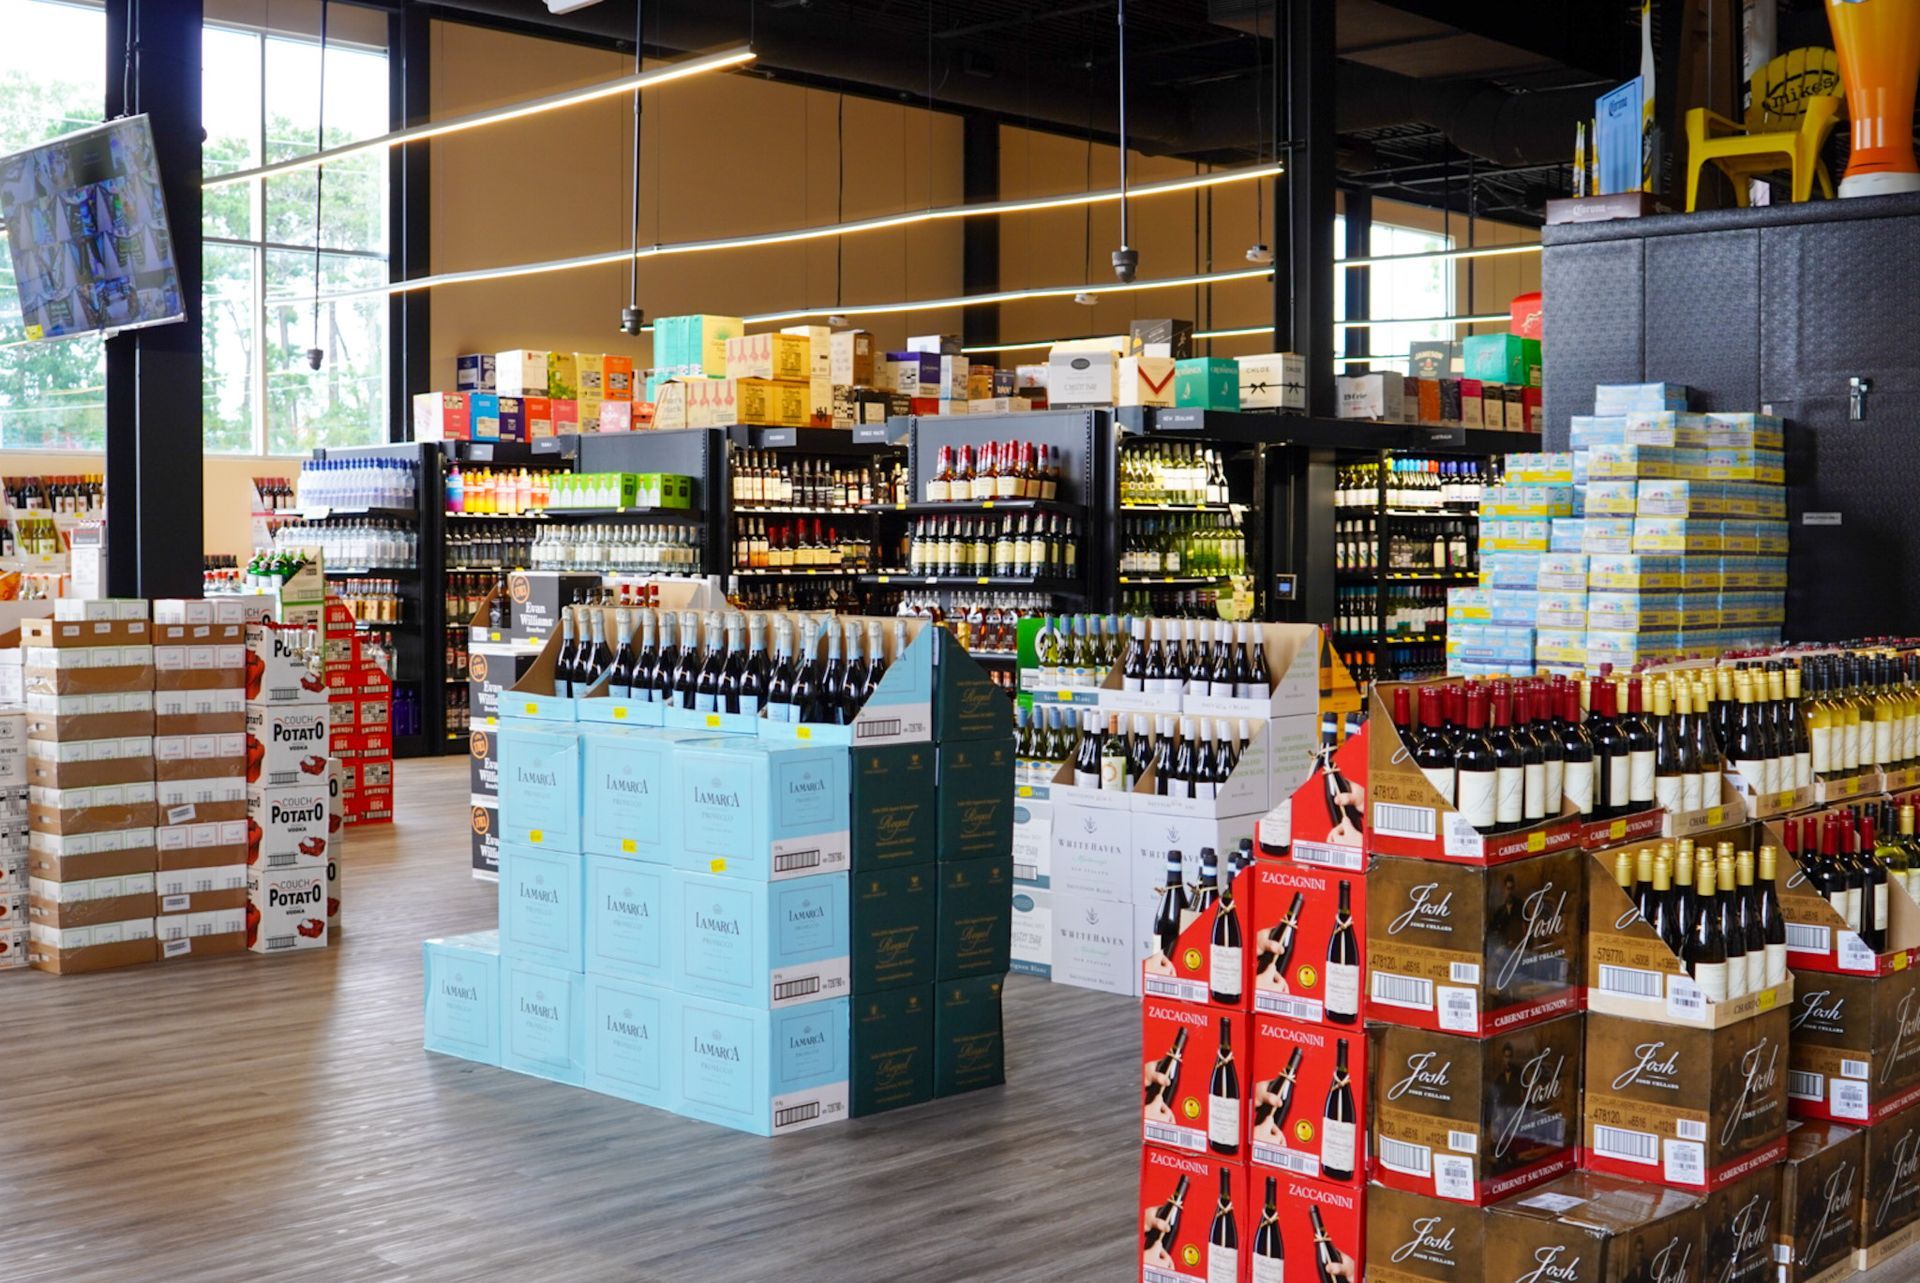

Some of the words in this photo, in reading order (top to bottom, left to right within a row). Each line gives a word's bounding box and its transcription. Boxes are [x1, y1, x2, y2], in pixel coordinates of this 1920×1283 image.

[1572, 204, 1606, 217] Corona
[525, 601, 546, 614] Evan
[519, 613, 554, 627] Williams
[284, 715, 313, 724] COUCH
[273, 721, 324, 742] POTATO
[271, 802, 323, 824] POTATO
[282, 797, 312, 806] COUCH
[1058, 838, 1122, 855] WHITEHAVEN
[1498, 844, 1529, 857] CABERNE
[280, 878, 310, 889] COUCH
[1261, 871, 1326, 891] ZACCAGNINI
[269, 884, 321, 907] POTATO
[1388, 882, 1452, 935] Josh
[1060, 929, 1125, 946] WHITEHAVEN
[1496, 881, 1567, 990] Josh
[1148, 1006, 1208, 1027] ZACCAGNINI
[1494, 1010, 1529, 1028] CABERNET
[1530, 998, 1568, 1018] SAUVIGNON
[1790, 990, 1844, 1032] Josh
[1260, 1024, 1325, 1047] ZACCAGNINI
[1387, 1051, 1451, 1100] Josh
[1612, 1041, 1679, 1090] Josh
[1495, 1047, 1565, 1158] Josh
[1721, 1036, 1779, 1146] Josh
[1150, 1152, 1209, 1175] ZACCAGNINI
[1718, 1161, 1749, 1181] CABERNET
[1749, 1147, 1779, 1170] SAUVIGNON
[1492, 1176, 1528, 1195] CABERNET
[1528, 1161, 1564, 1182] SAUVIGNON
[1288, 1184, 1353, 1209] ZACCAGNINI
[1804, 1161, 1856, 1266] Josh
[1391, 1216, 1455, 1263] Josh
[1719, 1194, 1770, 1283] Josh
[1515, 1245, 1580, 1283] Josh
